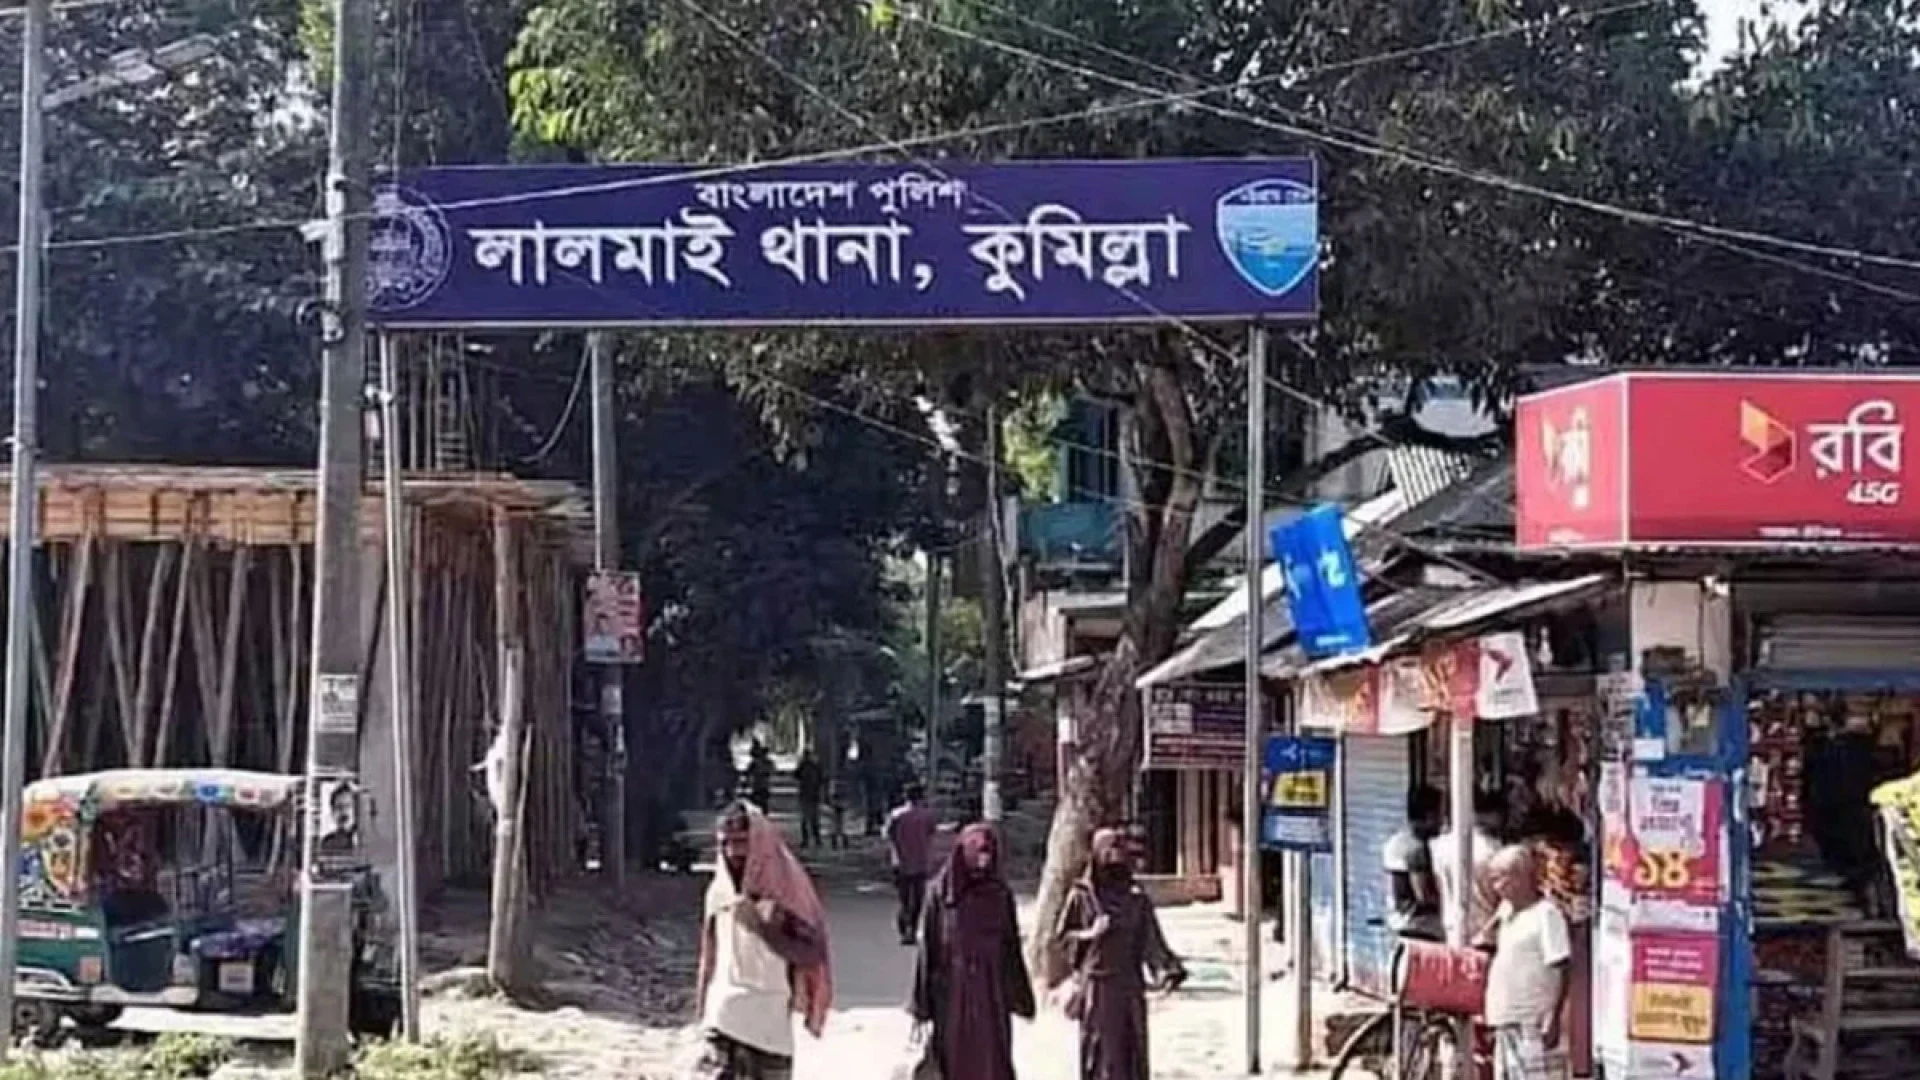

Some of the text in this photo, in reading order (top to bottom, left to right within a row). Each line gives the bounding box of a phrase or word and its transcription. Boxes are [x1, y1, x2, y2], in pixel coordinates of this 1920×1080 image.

[694, 172, 966, 214] বাংলাদেশ পুলিশ
[468, 207, 735, 287] লালমাই
[761, 216, 934, 291] থানা,
[962, 204, 1192, 301] কুমিল্লা
[1805, 399, 1904, 480] রবি
